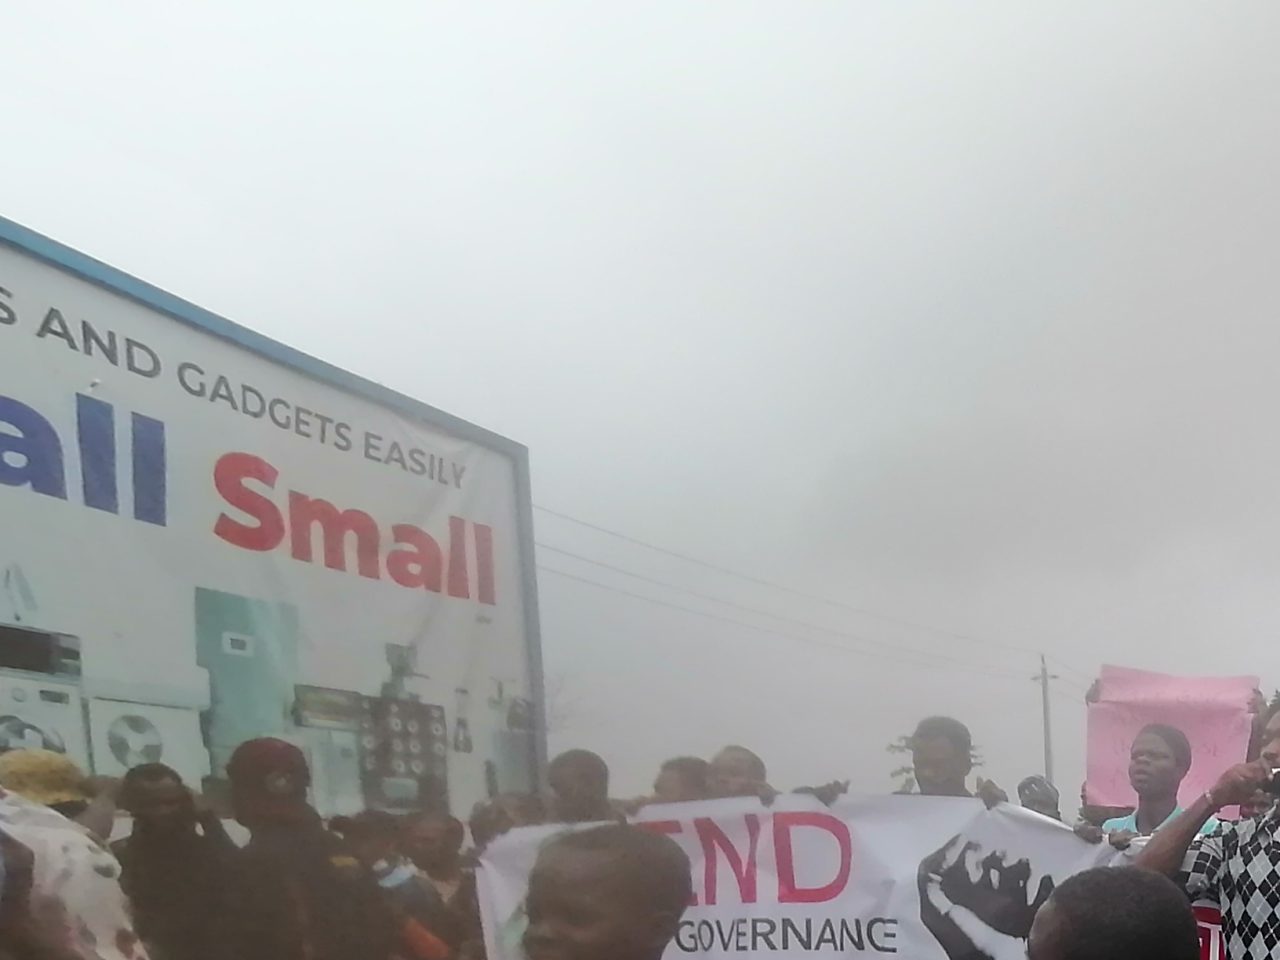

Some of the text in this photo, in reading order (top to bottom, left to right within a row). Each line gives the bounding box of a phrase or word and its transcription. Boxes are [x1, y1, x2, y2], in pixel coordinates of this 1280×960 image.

[36, 306, 161, 378] AND
[177, 362, 352, 451] GADGETS
[364, 431, 466, 488] EASILY
[0, 392, 496, 605] all Small
[674, 917, 898, 953] GOVERNANCE
